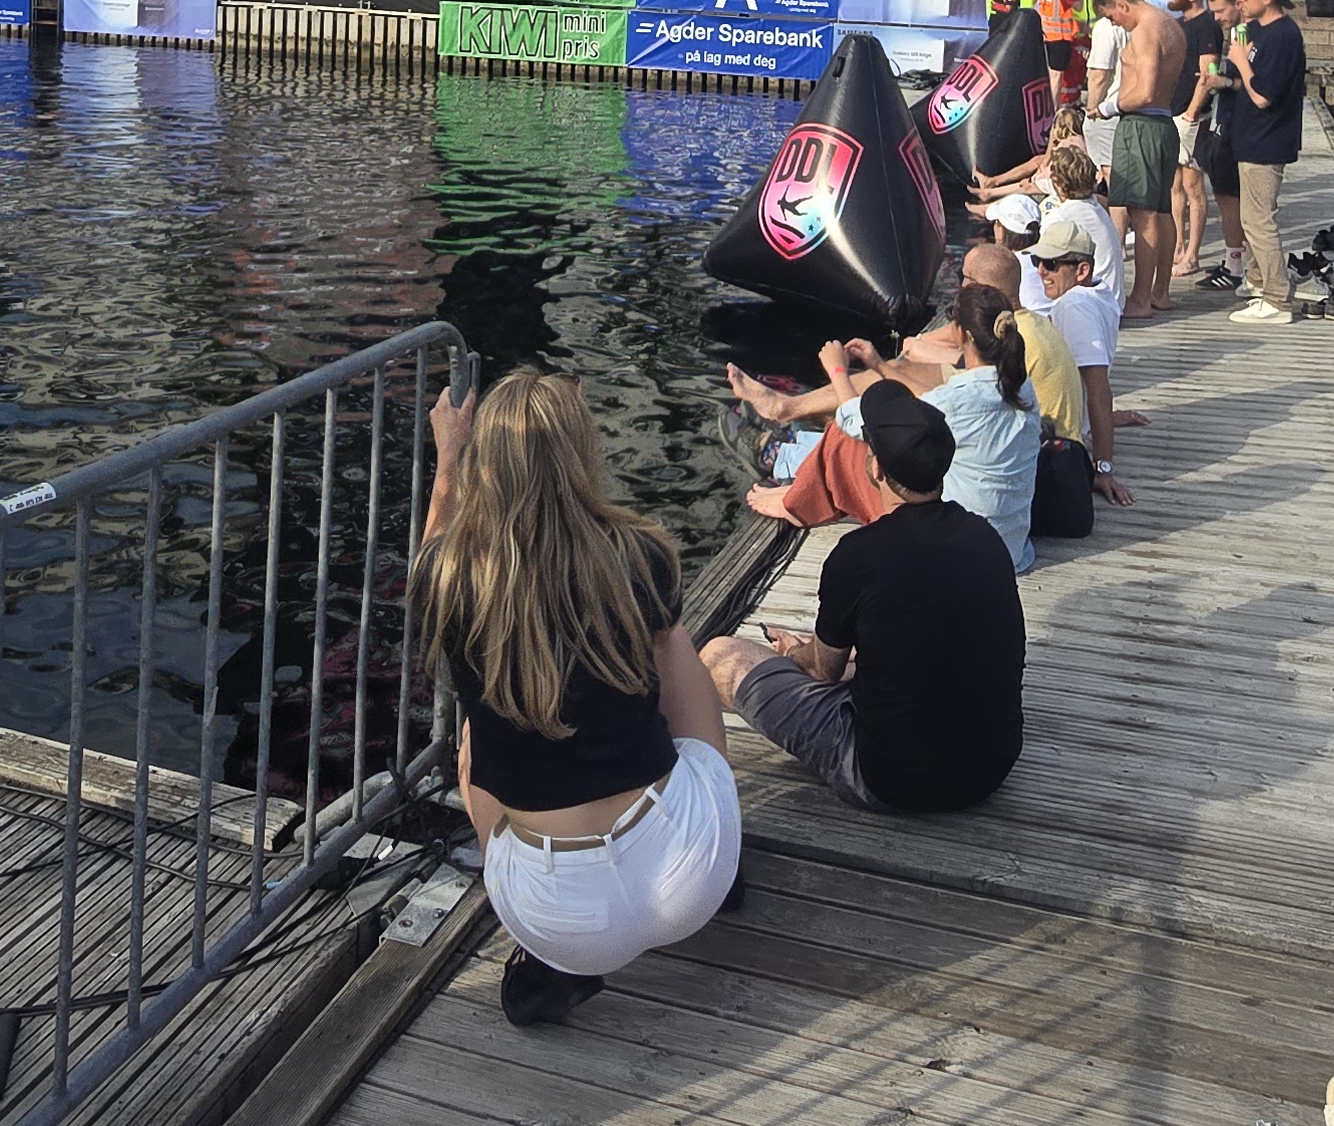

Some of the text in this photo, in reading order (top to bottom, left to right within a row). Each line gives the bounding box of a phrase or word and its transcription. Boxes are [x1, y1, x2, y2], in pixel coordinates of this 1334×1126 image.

[459, 6, 607, 58] KIWI mini
[562, 36, 600, 61] pris
[655, 19, 823, 49] Agder Sparebank
[685, 50, 701, 64] på
[703, 50, 722, 66] lag
[724, 52, 751, 66] med
[753, 54, 777, 70] deg
[949, 62, 984, 103] DDL
[775, 137, 838, 195] DDL
